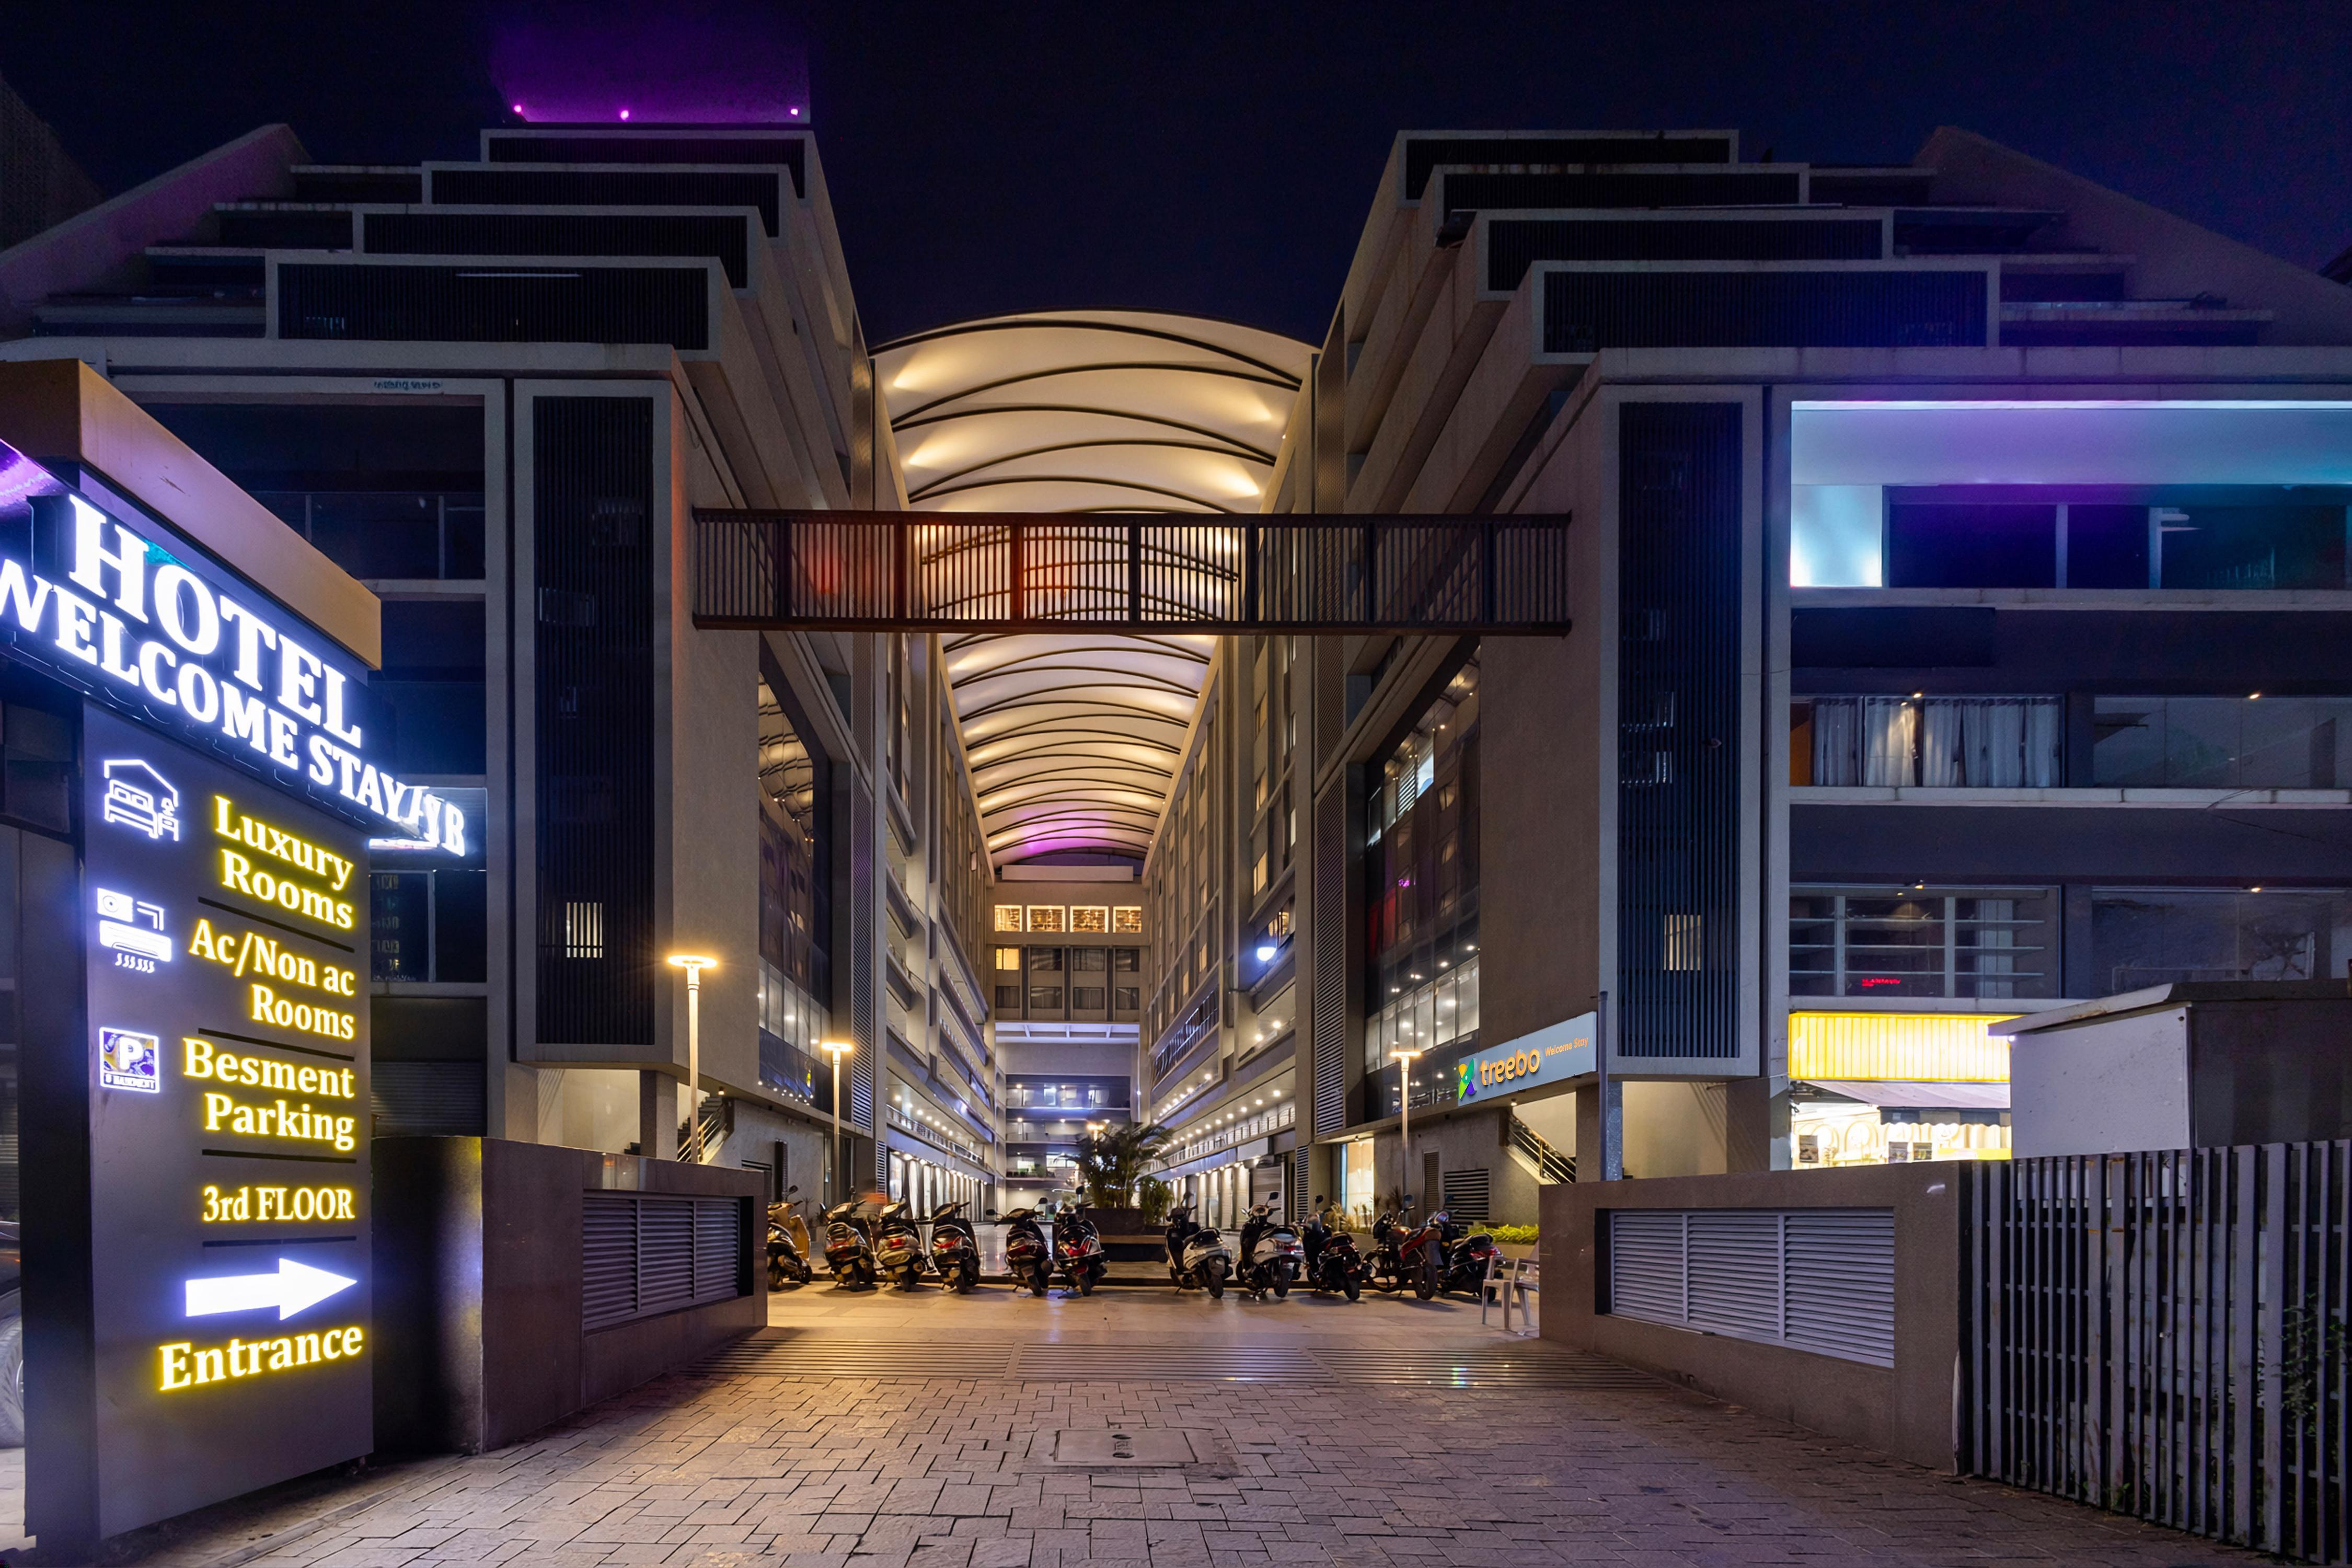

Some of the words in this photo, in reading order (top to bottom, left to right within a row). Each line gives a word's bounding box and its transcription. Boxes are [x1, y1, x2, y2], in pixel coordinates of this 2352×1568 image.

[69, 494, 361, 748] HOTEL
[0, 559, 298, 770] WELCOME
[309, 735, 408, 823] STAY
[215, 795, 353, 890] Luxury
[221, 849, 353, 929] Rooms
[189, 919, 317, 986] Ac/Non
[323, 966, 354, 996] ac
[251, 984, 354, 1040] Rooms
[183, 1037, 354, 1098] Besment
[1479, 1048, 1541, 1086] treebo
[1545, 1043, 1573, 1057] Welcome
[1574, 1037, 1589, 1048] Stay
[204, 1093, 354, 1151] Parking
[203, 1186, 250, 1221] 3rd
[256, 1187, 355, 1220] FLOOR
[159, 1327, 363, 1391] Entrance
